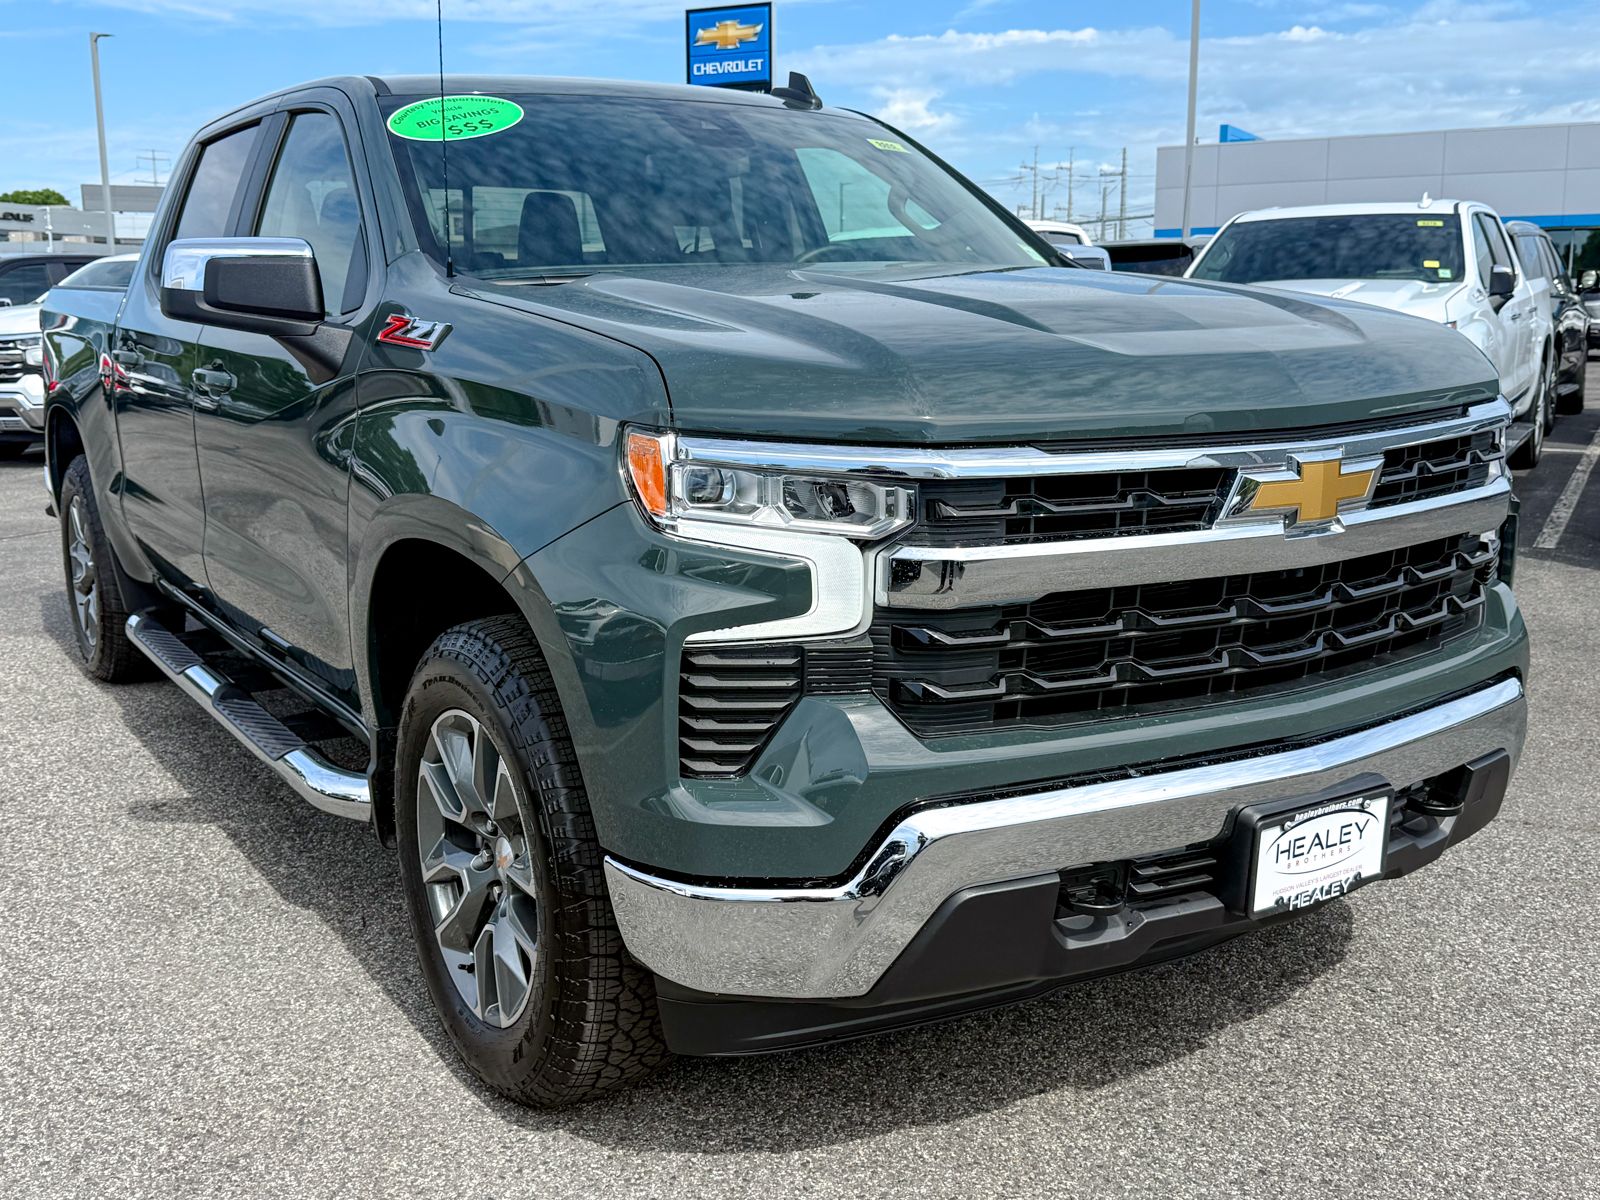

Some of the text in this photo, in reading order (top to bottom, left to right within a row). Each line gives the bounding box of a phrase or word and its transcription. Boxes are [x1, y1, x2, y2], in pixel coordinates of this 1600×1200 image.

[693, 59, 764, 76] CHEVROLET
[393, 104, 425, 125] Courtesy
[416, 107, 500, 129] BIG SAVINGS
[448, 119, 494, 135] $$$
[377, 313, 453, 352] Z71
[1275, 818, 1371, 864] HEALEY
[1287, 846, 1351, 869] BROTHERS
[1288, 877, 1351, 911] HEALEY
